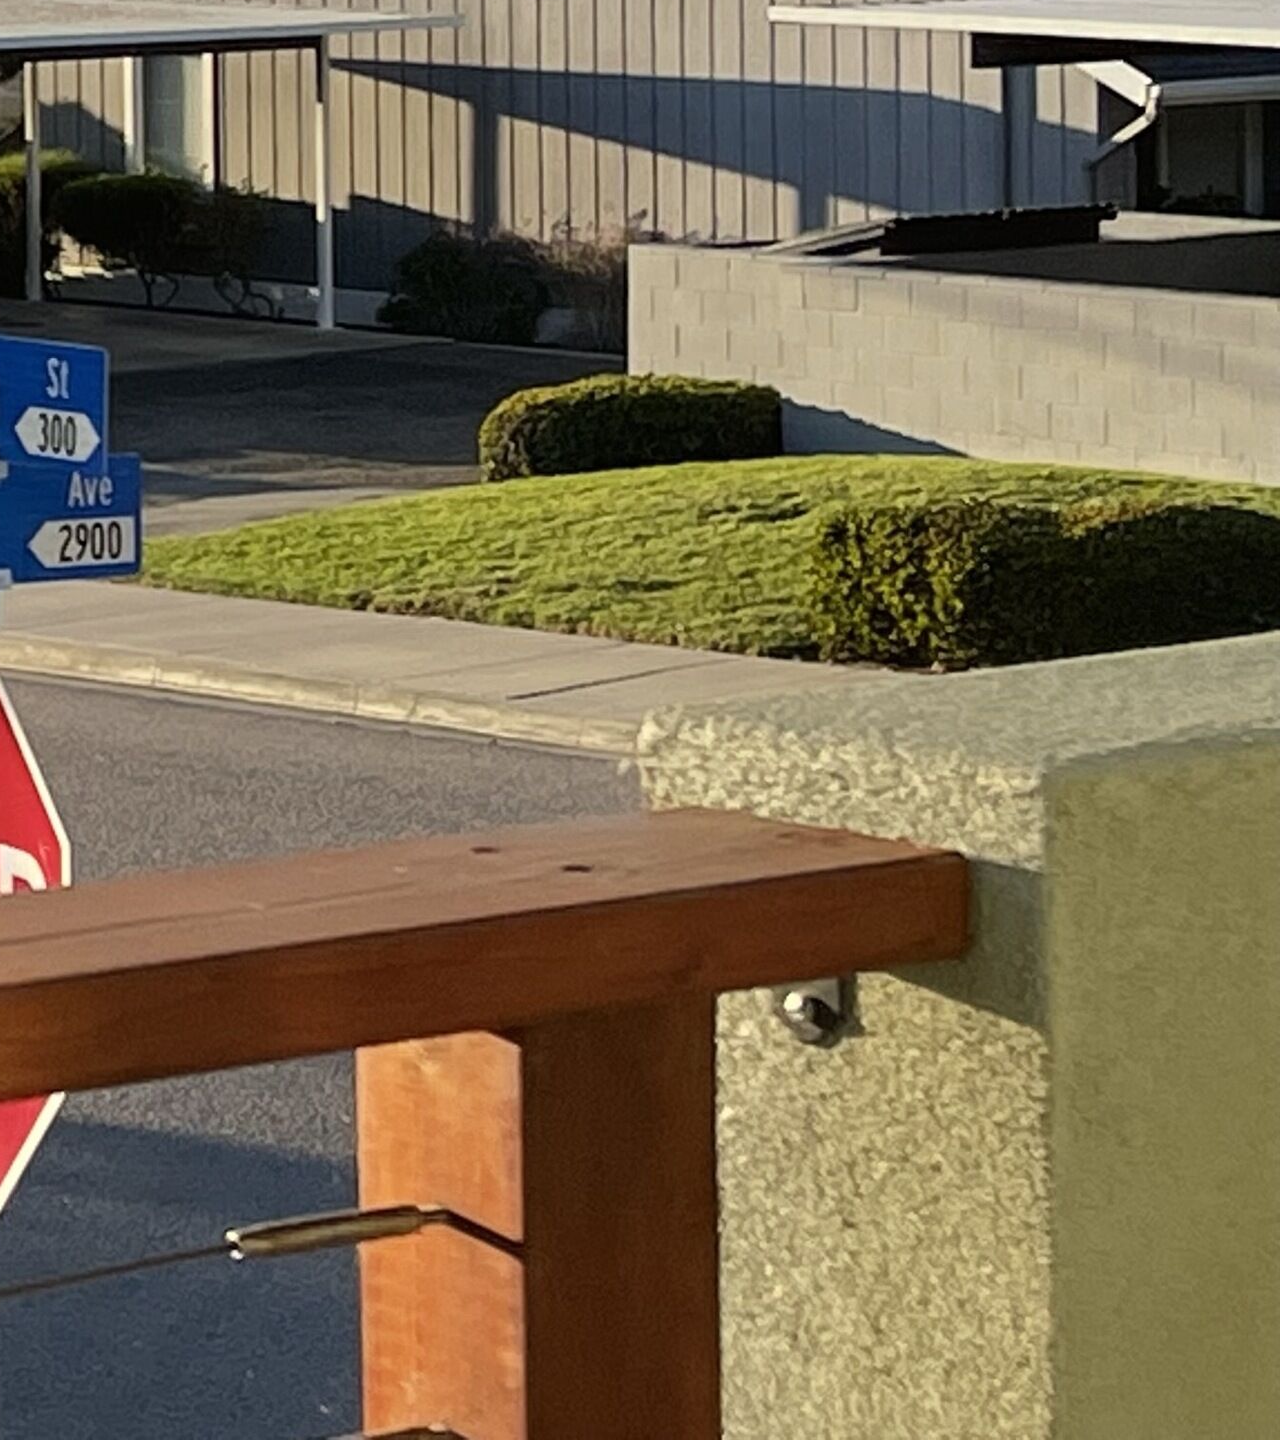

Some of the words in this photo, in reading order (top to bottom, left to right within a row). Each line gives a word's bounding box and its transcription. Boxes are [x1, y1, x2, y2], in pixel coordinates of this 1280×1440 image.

[46, 357, 70, 400] St
[37, 412, 76, 457] 300
[67, 471, 114, 508] Ave
[58, 520, 122, 563] 2900
